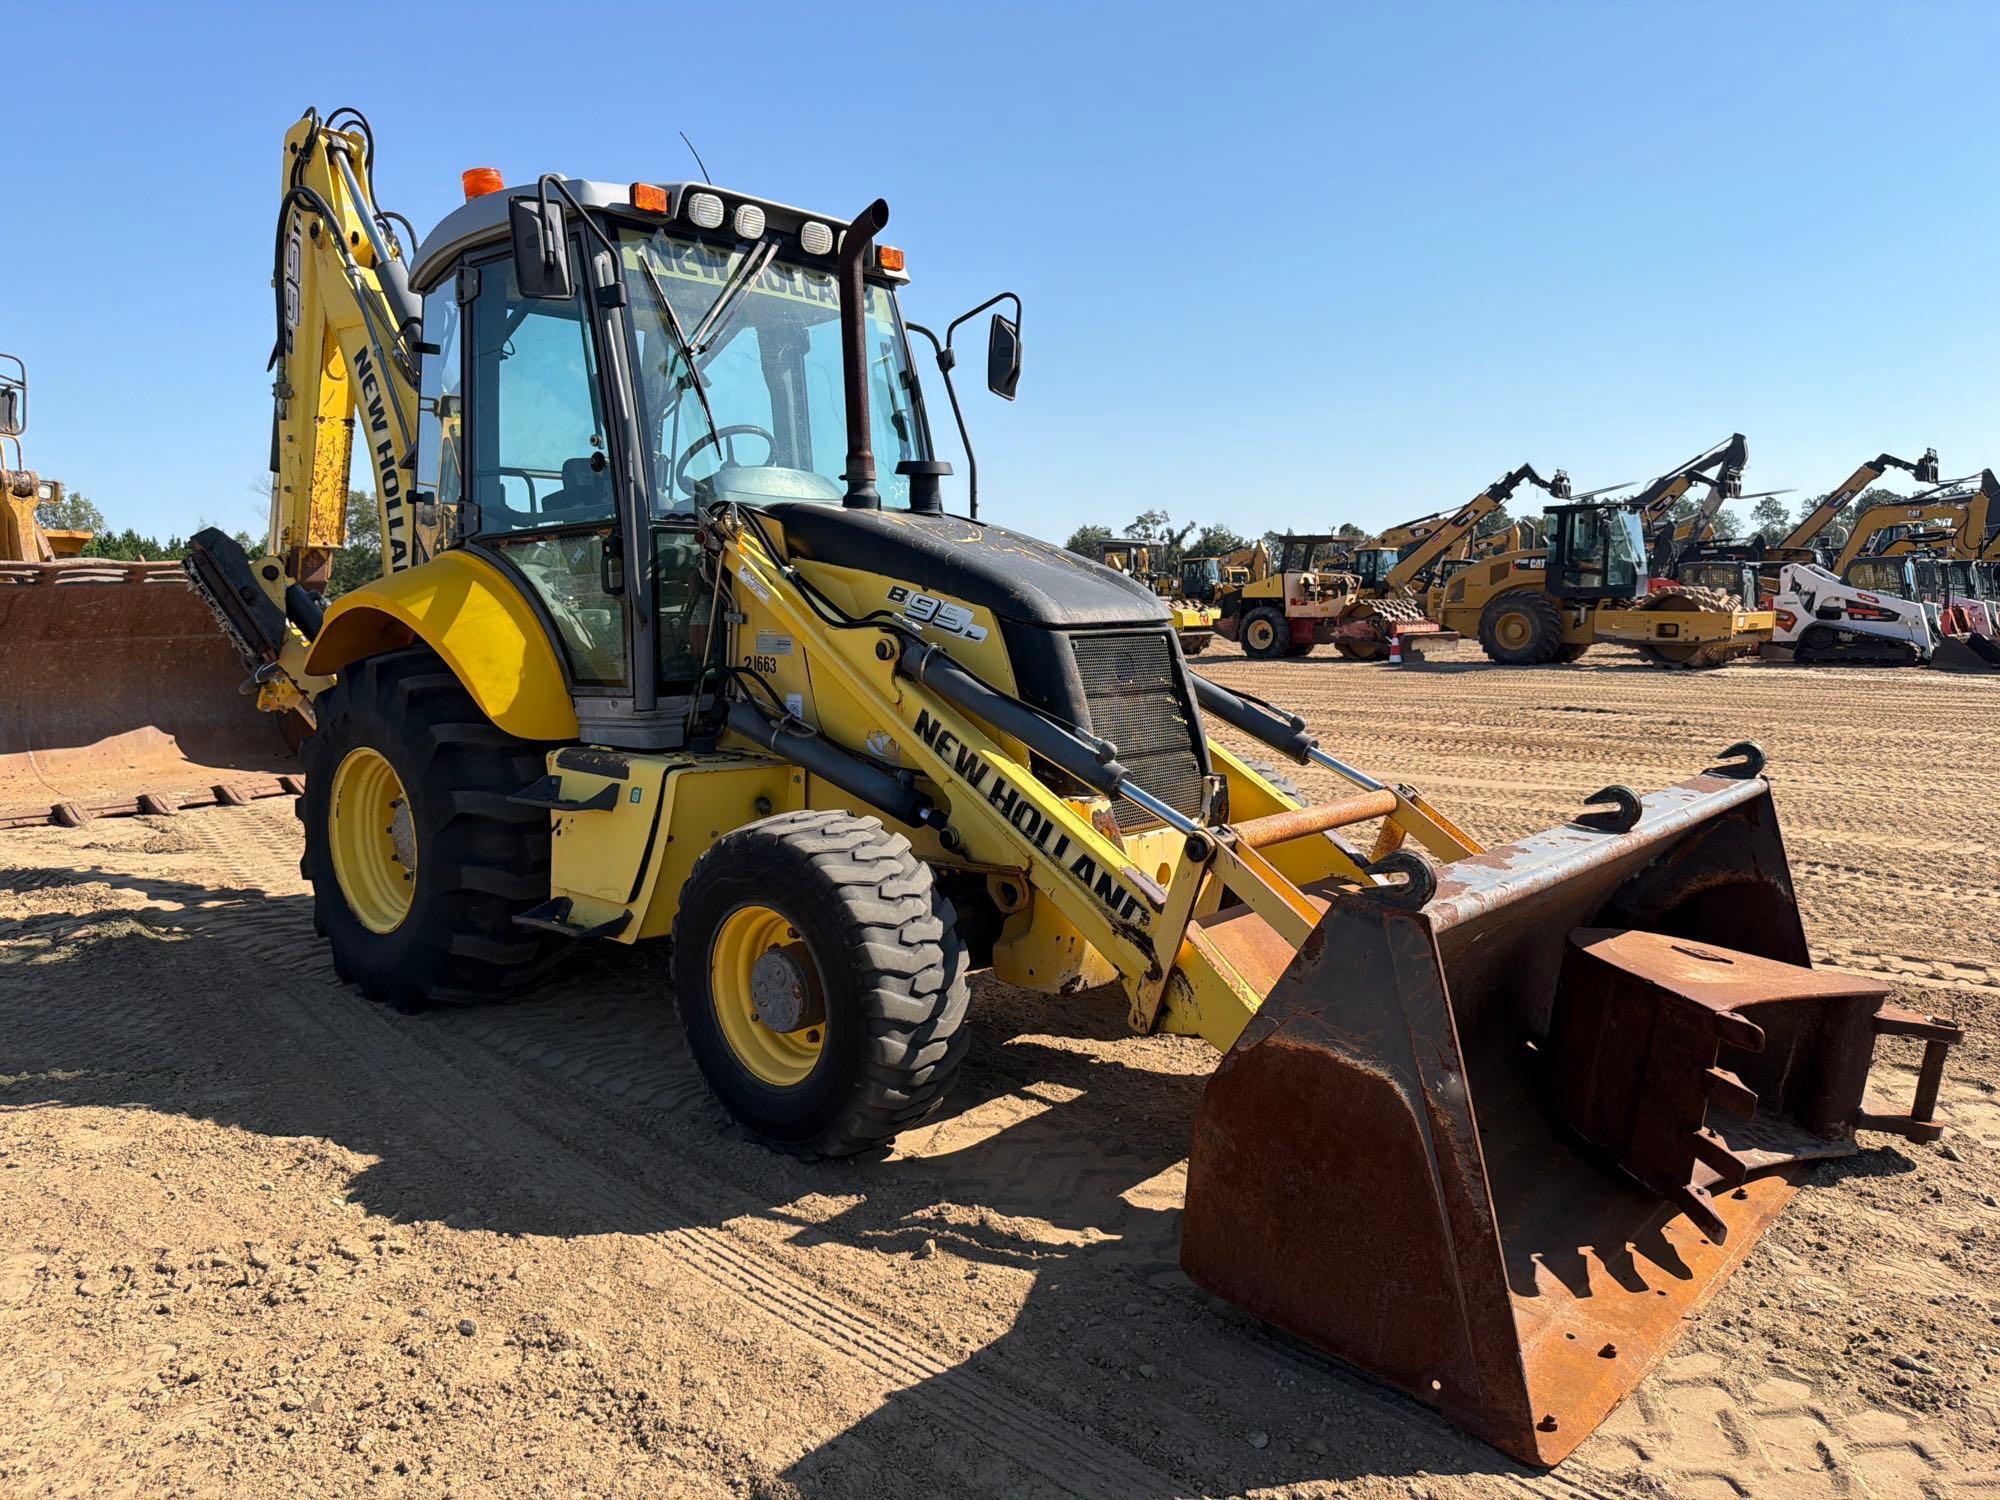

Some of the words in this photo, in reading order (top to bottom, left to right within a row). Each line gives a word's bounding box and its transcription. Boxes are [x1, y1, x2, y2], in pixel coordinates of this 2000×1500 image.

[354, 345, 388, 432] NEW
[377, 438, 407, 574] HOLLA
[1415, 528, 1425, 537] CAT
[1530, 559, 1546, 569] CAT
[744, 655, 776, 674] 21663
[913, 708, 991, 789] NEW
